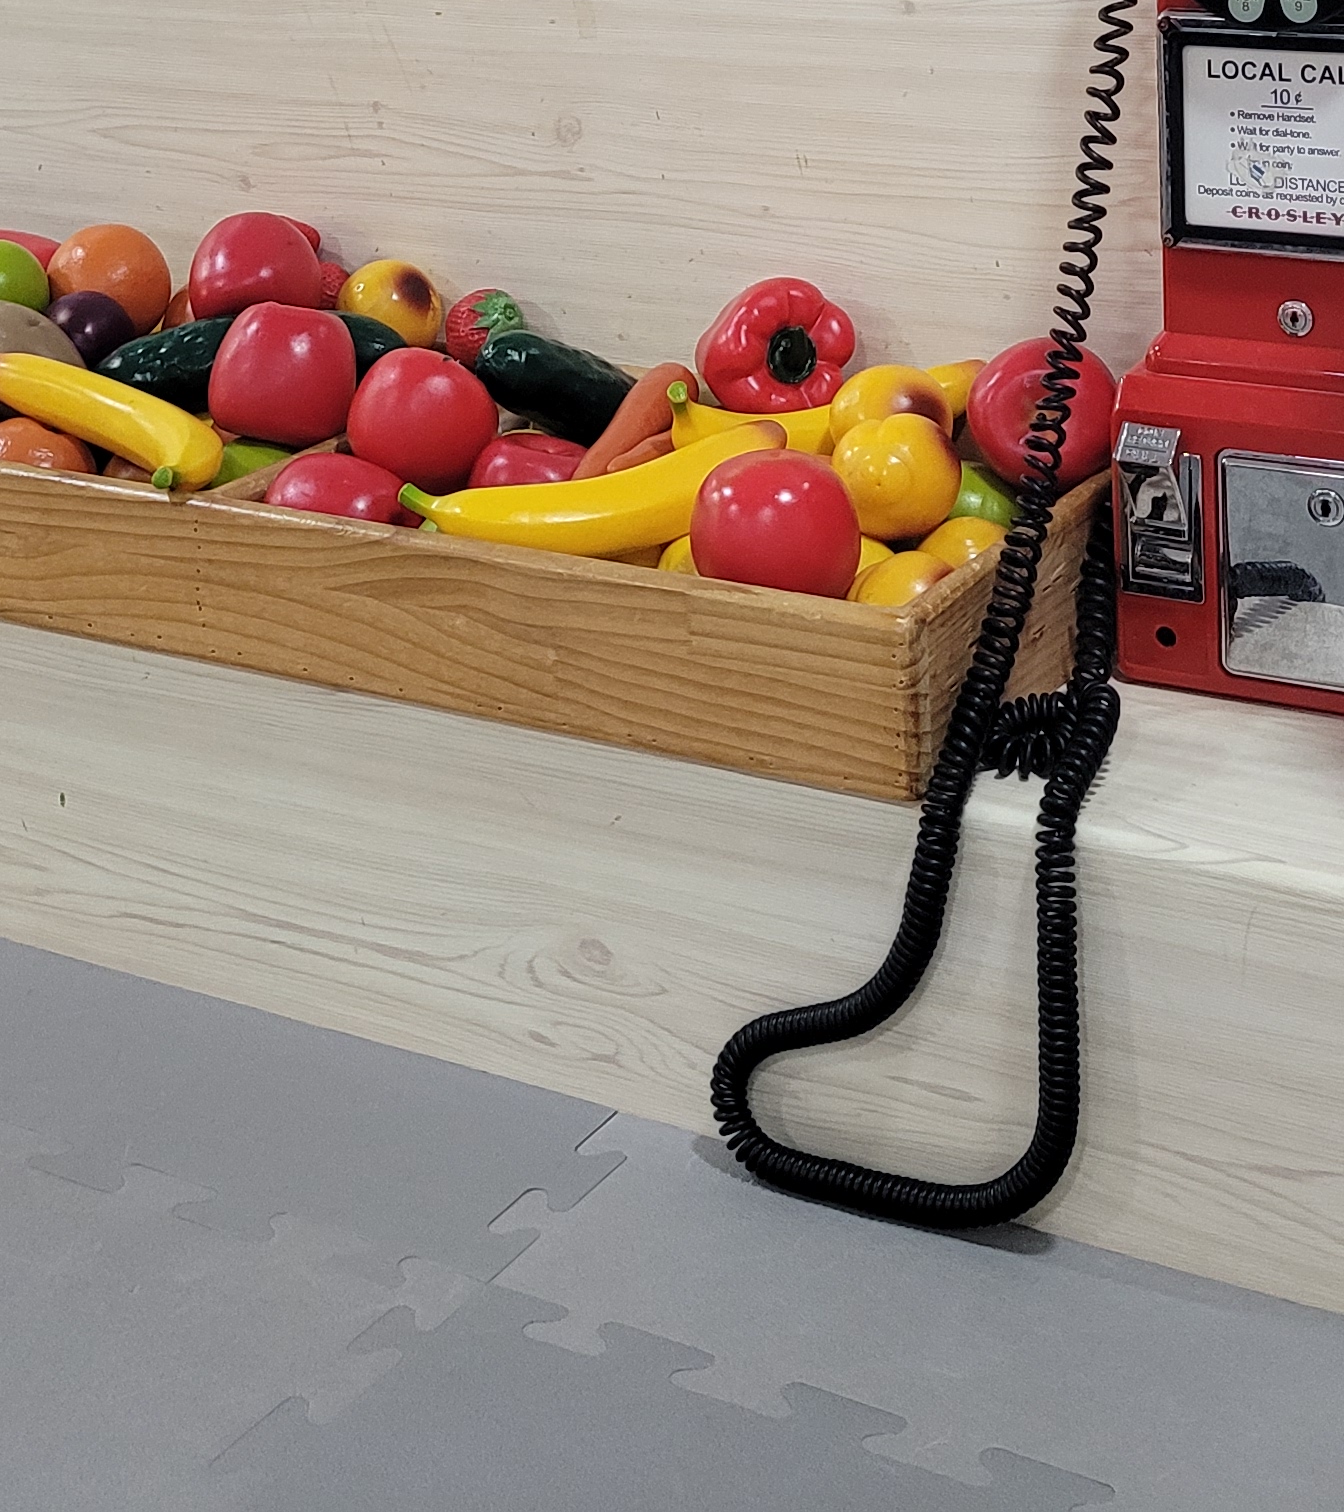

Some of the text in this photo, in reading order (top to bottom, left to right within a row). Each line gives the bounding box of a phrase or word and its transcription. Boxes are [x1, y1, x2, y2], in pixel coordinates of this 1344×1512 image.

[1242, 1, 1251, 12] 8
[1295, 1, 1303, 12] 9
[1206, 58, 1292, 83] LOCAL
[1237, 109, 1317, 124] Remove Handset.
[1236, 125, 1257, 136] Wait
[1259, 126, 1270, 137] for
[1259, 142, 1270, 153] for
[1272, 144, 1296, 157] party
[1297, 144, 1306, 155] to
[1307, 147, 1342, 158] answer.
[1197, 184, 1234, 198] Deposit
[1235, 188, 1261, 199] coins
[1261, 191, 1274, 200] as
[1275, 192, 1324, 205] requested
[1325, 193, 1337, 207] by
